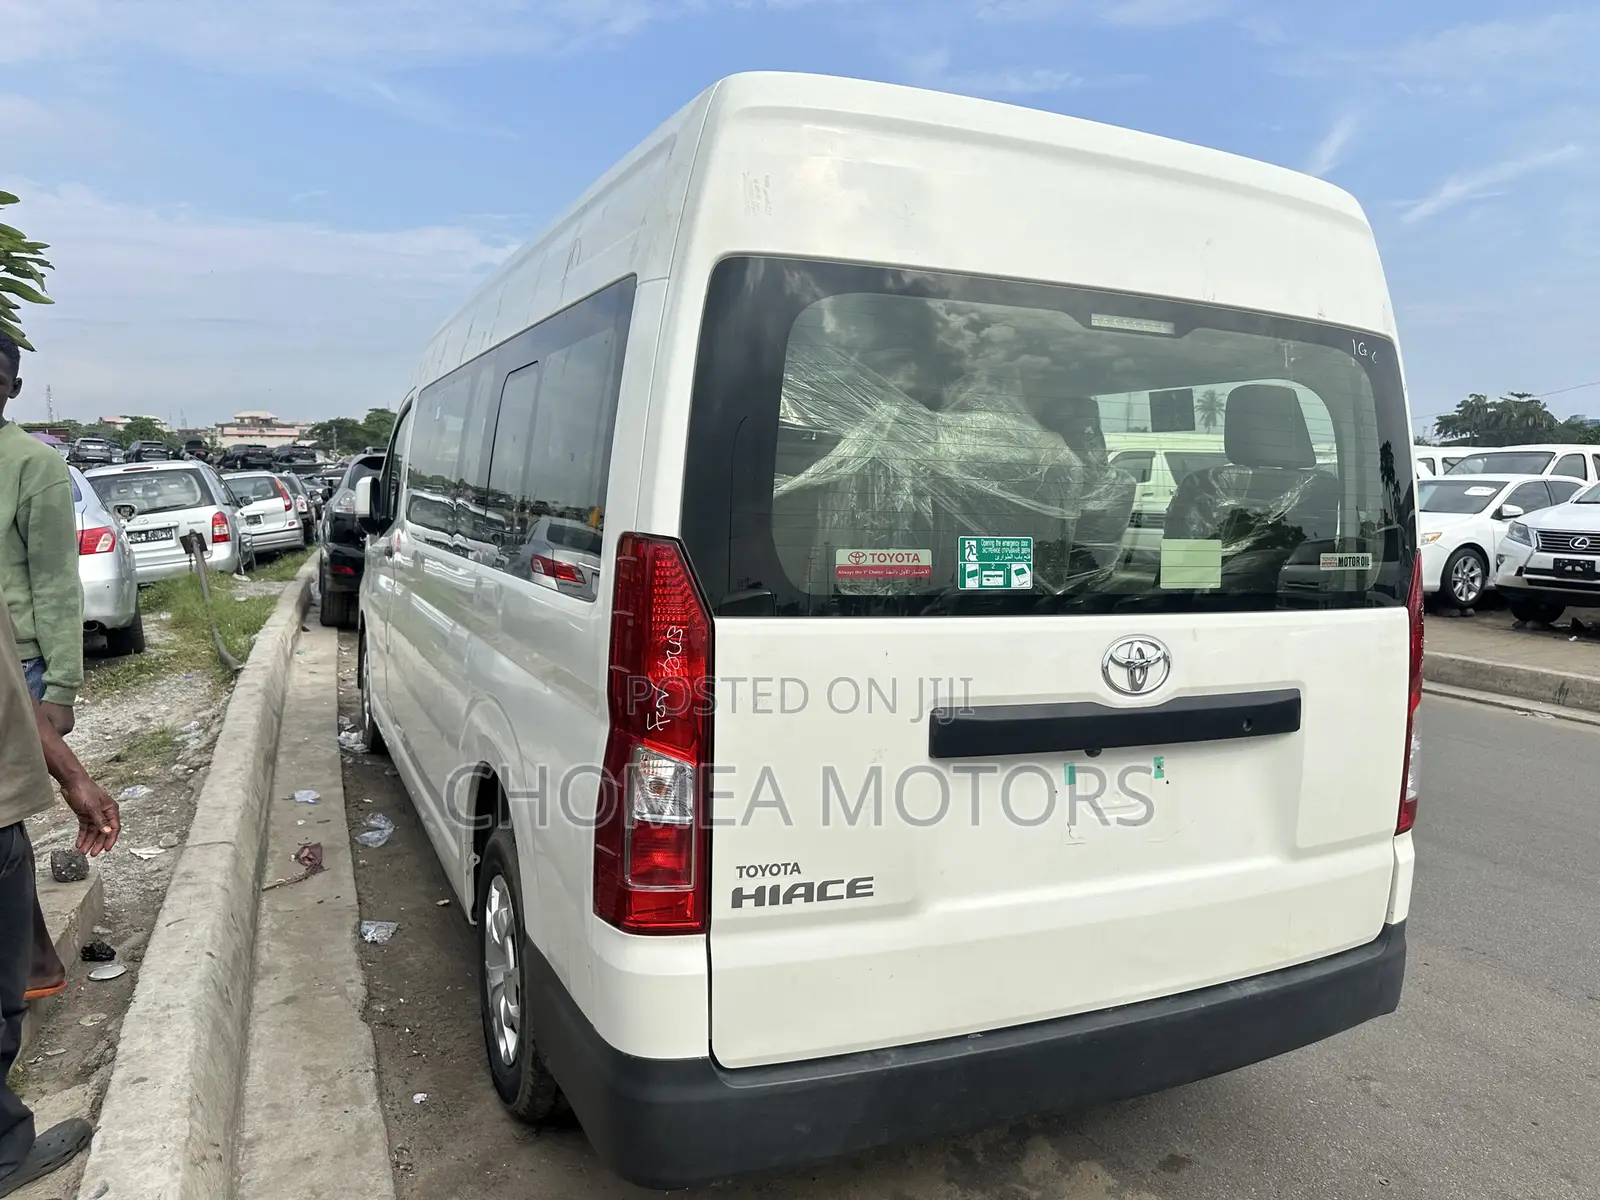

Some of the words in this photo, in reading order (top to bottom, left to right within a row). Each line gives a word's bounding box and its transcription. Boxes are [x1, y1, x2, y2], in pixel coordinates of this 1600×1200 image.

[981, 539, 994, 548] Opening
[869, 553, 920, 563] TOYOTA
[1338, 556, 1360, 567] MOTOR
[1361, 556, 1370, 567] OIL
[736, 862, 801, 878] TOYOTA
[731, 876, 874, 908] HIACE
